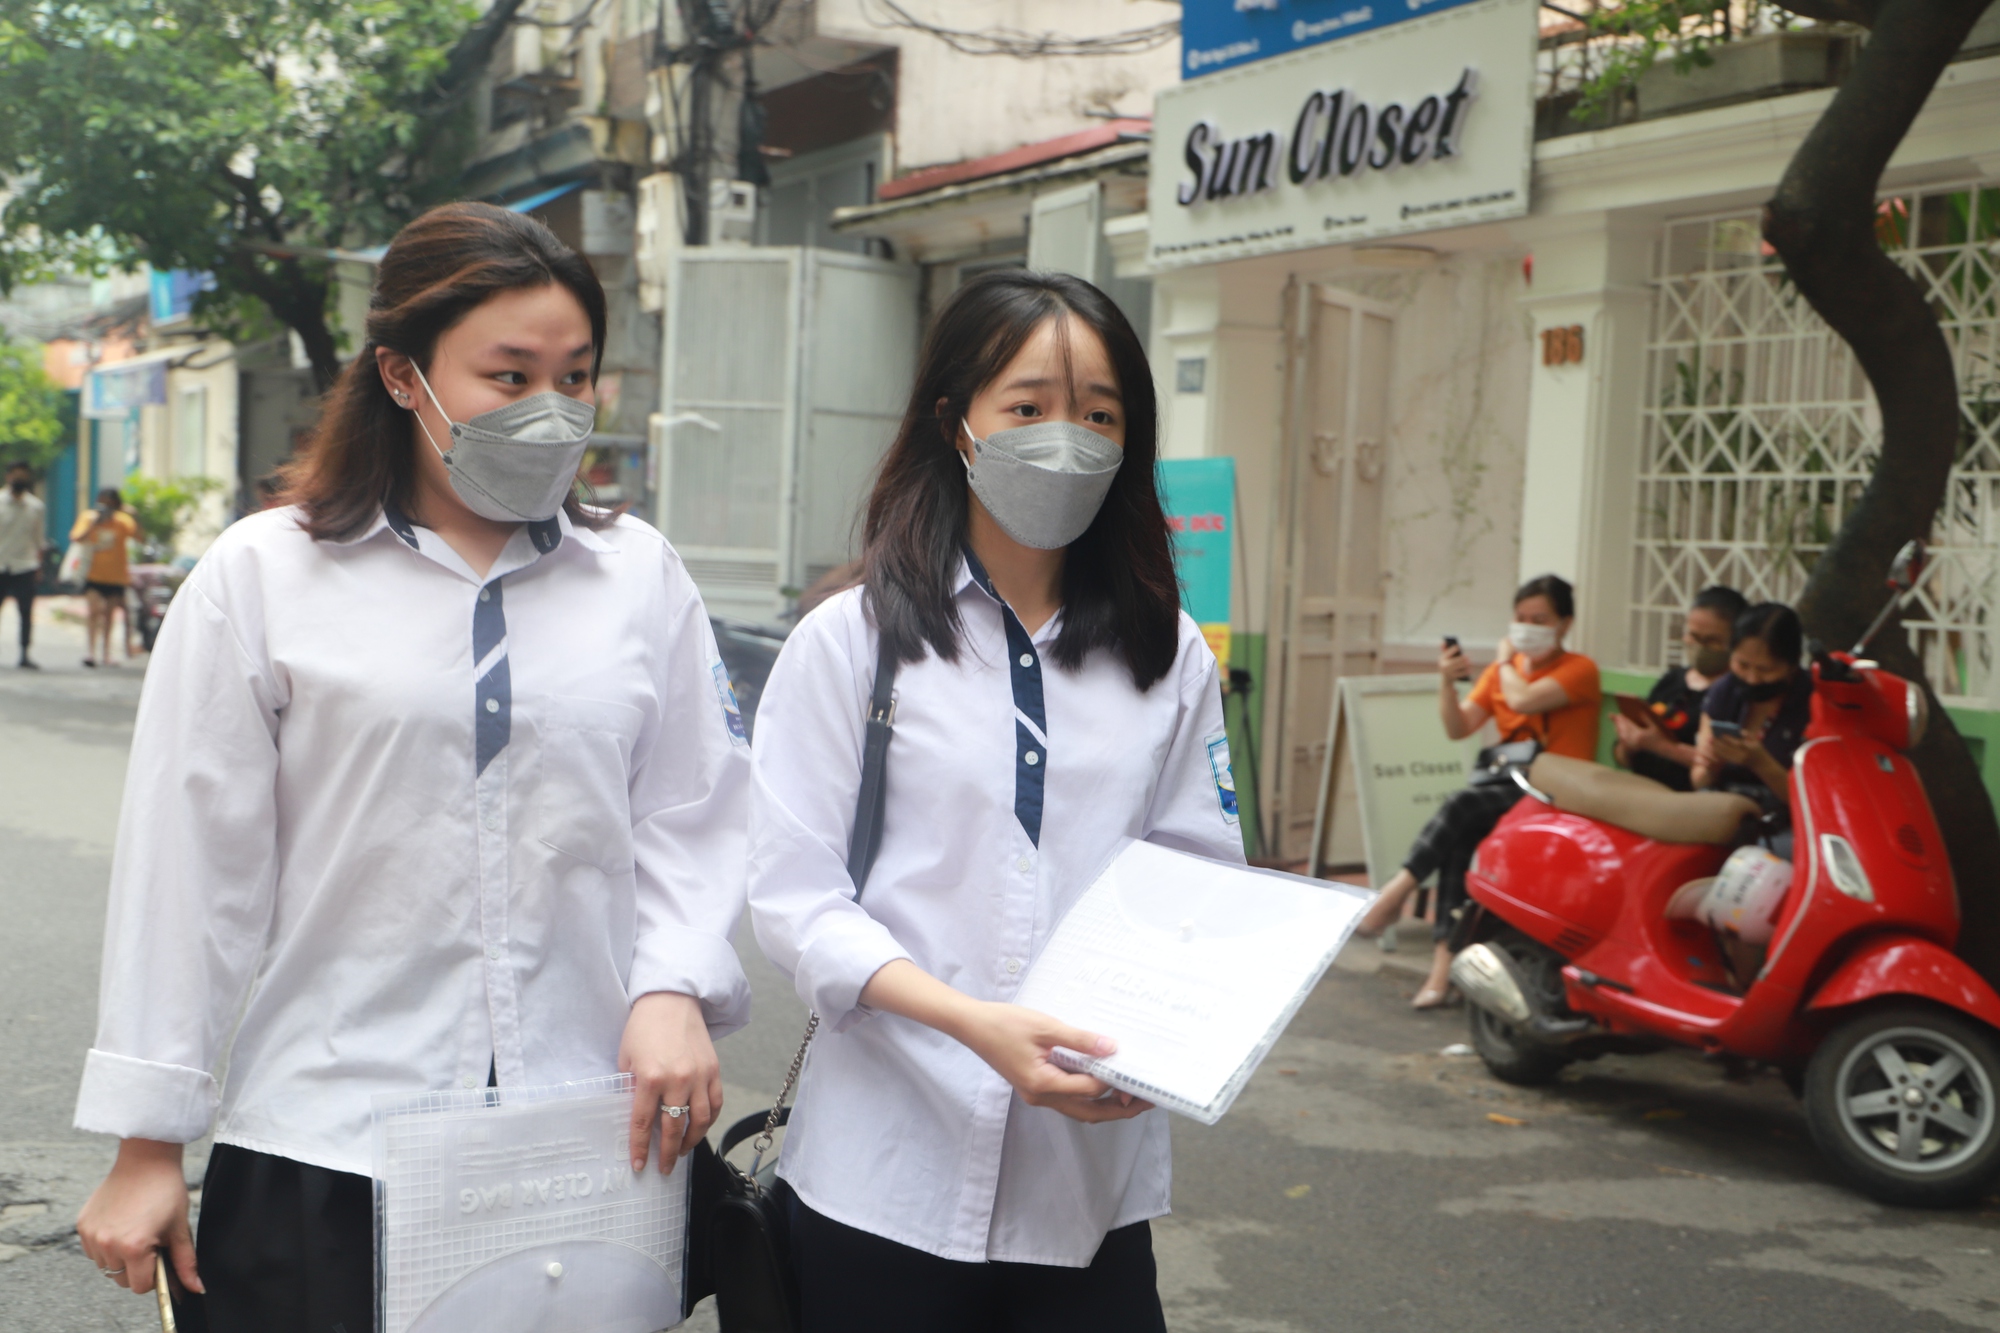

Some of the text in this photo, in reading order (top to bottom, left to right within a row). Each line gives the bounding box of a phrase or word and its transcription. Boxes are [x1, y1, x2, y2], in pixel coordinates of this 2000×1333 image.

[1178, 67, 1478, 206] Sun Closet
[1373, 761, 1463, 778] Sun Closet
[459, 1182, 514, 1215] BAG
[520, 1171, 594, 1206] CLEAR
